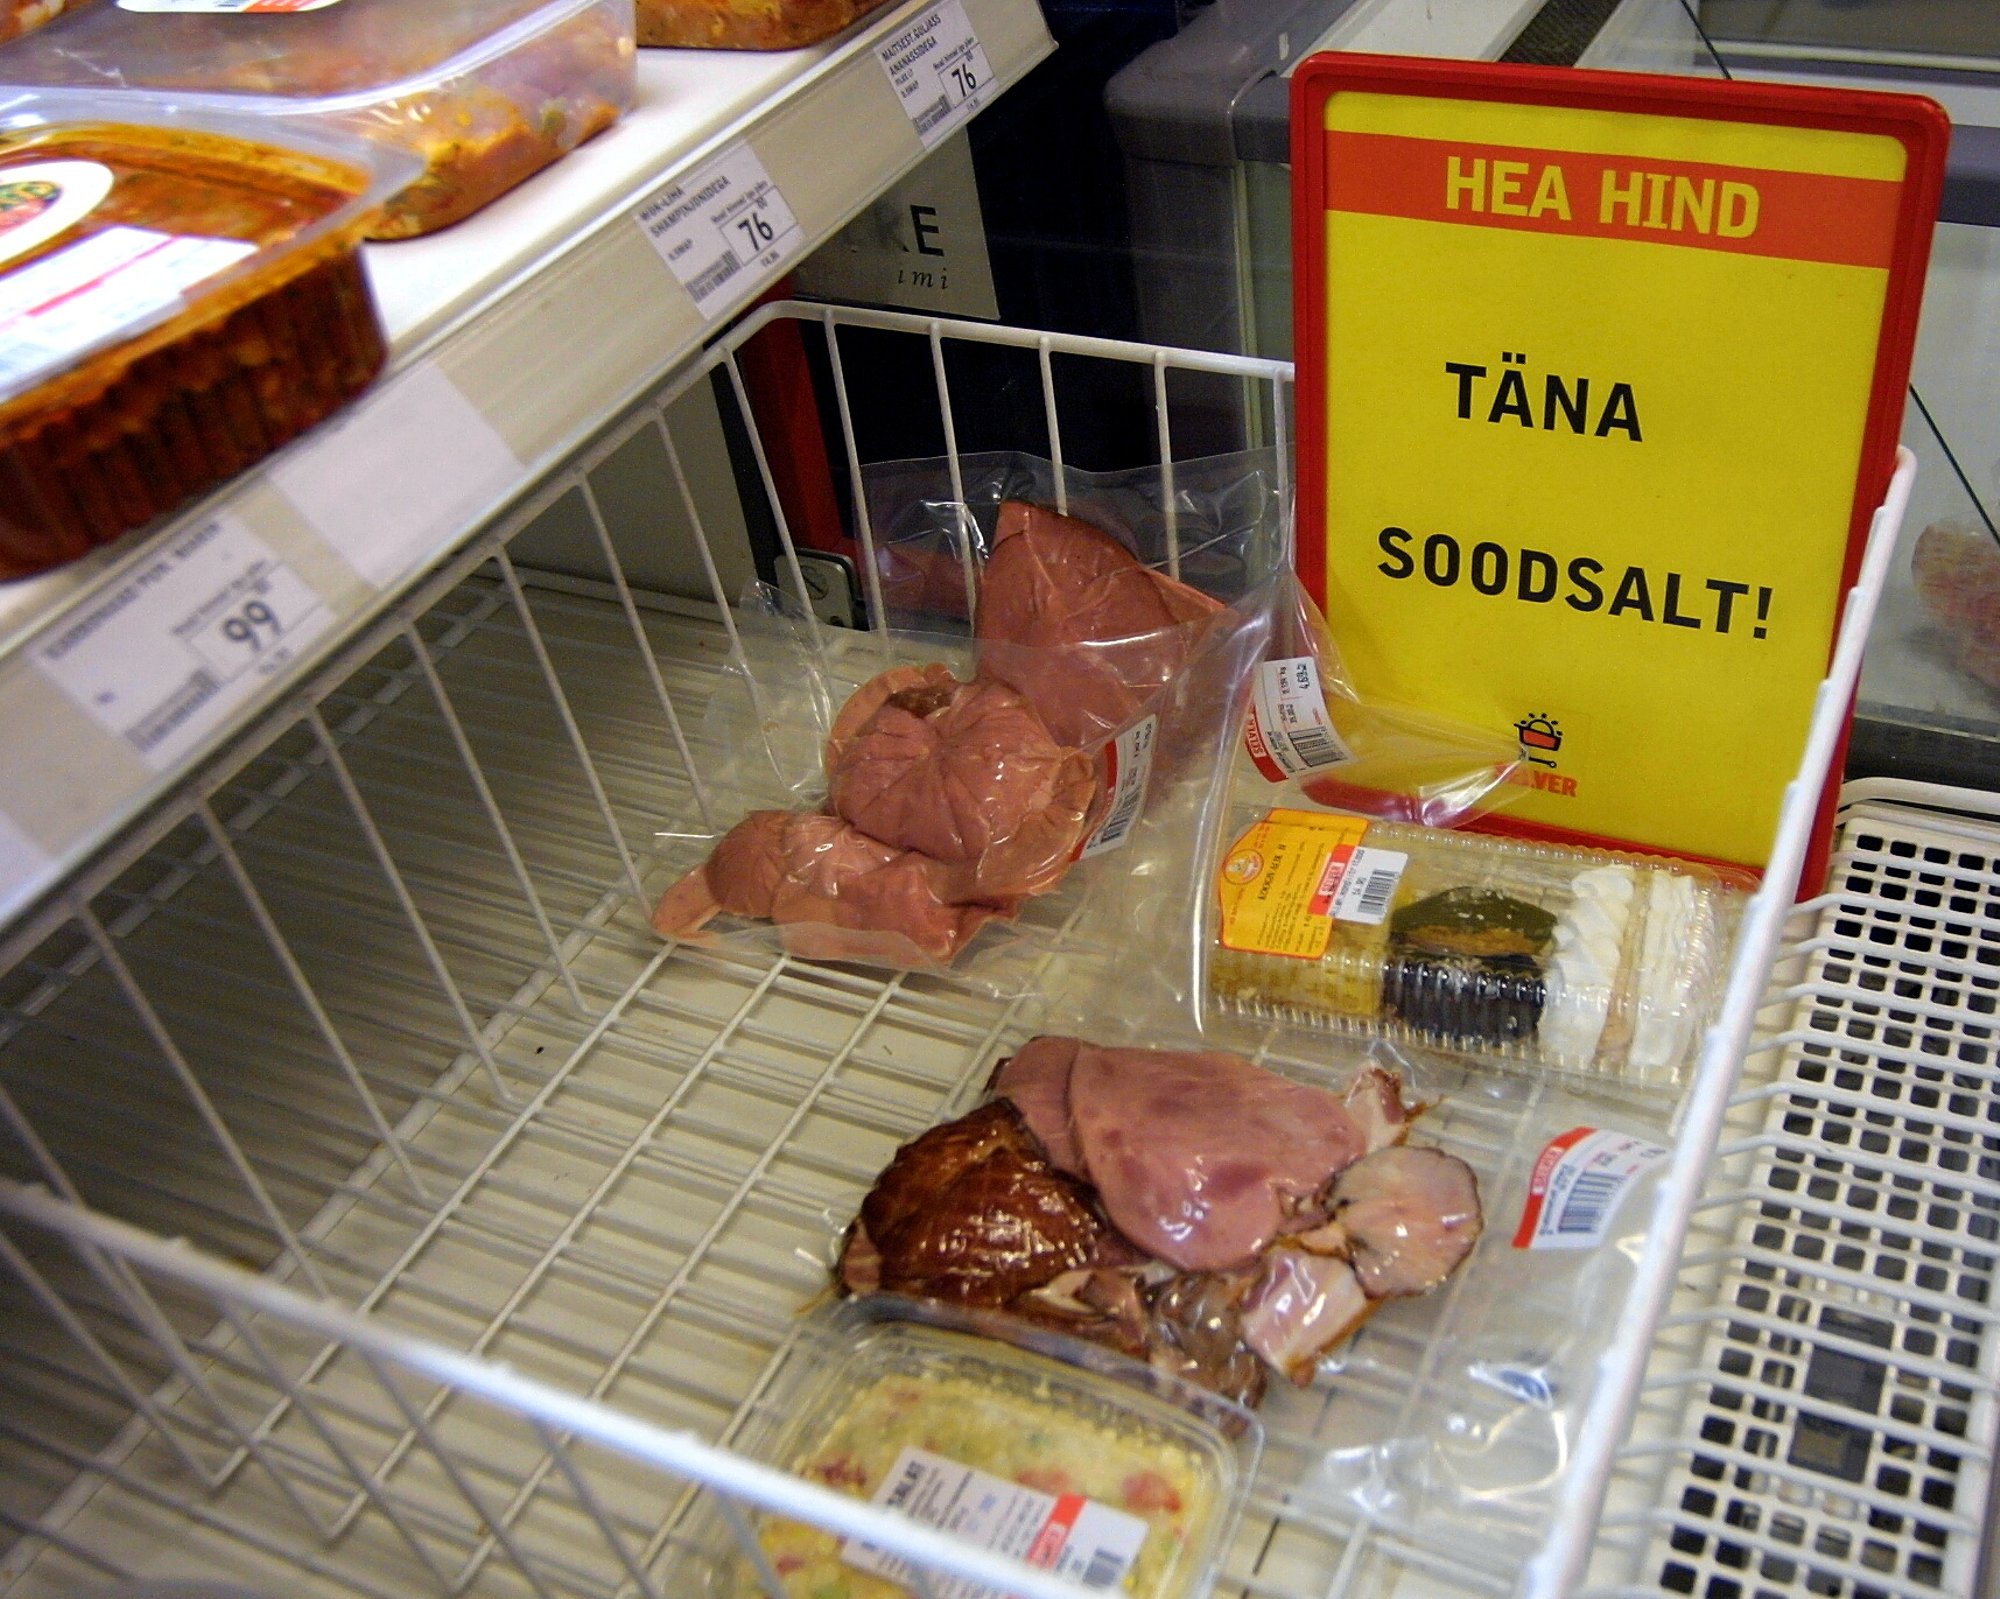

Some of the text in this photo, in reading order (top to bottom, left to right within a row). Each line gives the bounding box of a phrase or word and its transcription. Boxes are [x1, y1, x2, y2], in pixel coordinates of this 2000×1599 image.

[951, 63, 977, 97] 76
[1445, 155, 1761, 239] HEA HIND
[737, 212, 774, 251] 76
[1445, 351, 1643, 443] TÄNA
[1377, 526, 1774, 640] SOODSALT!
[221, 600, 282, 651] 99
